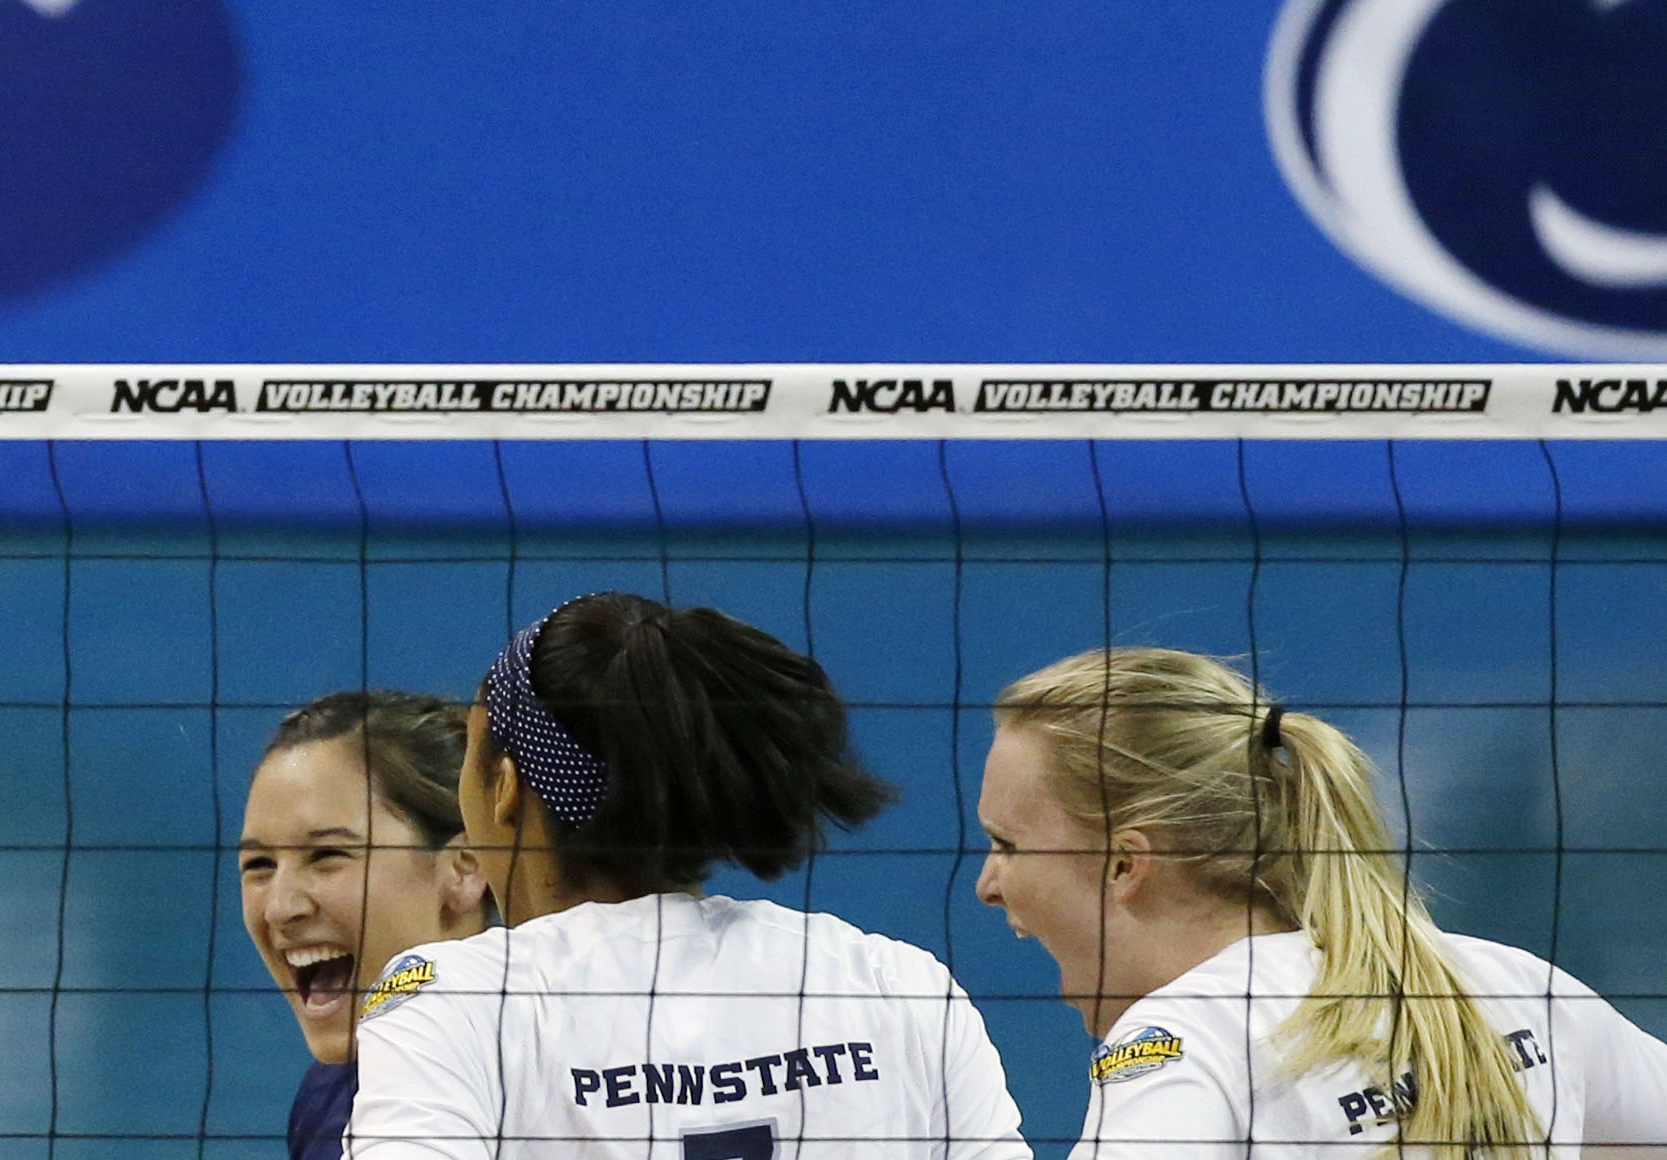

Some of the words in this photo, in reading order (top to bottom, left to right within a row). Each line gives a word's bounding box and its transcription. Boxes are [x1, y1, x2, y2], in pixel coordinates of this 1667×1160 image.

[111, 379, 238, 413] NCAA
[265, 381, 480, 411] VOLLEYBALL
[489, 381, 763, 411] CHAMPIONSHIP
[828, 379, 956, 413] NCAA
[983, 381, 1198, 411] VOLLEYBALL
[1207, 381, 1481, 411] CHAMPIONSHIP
